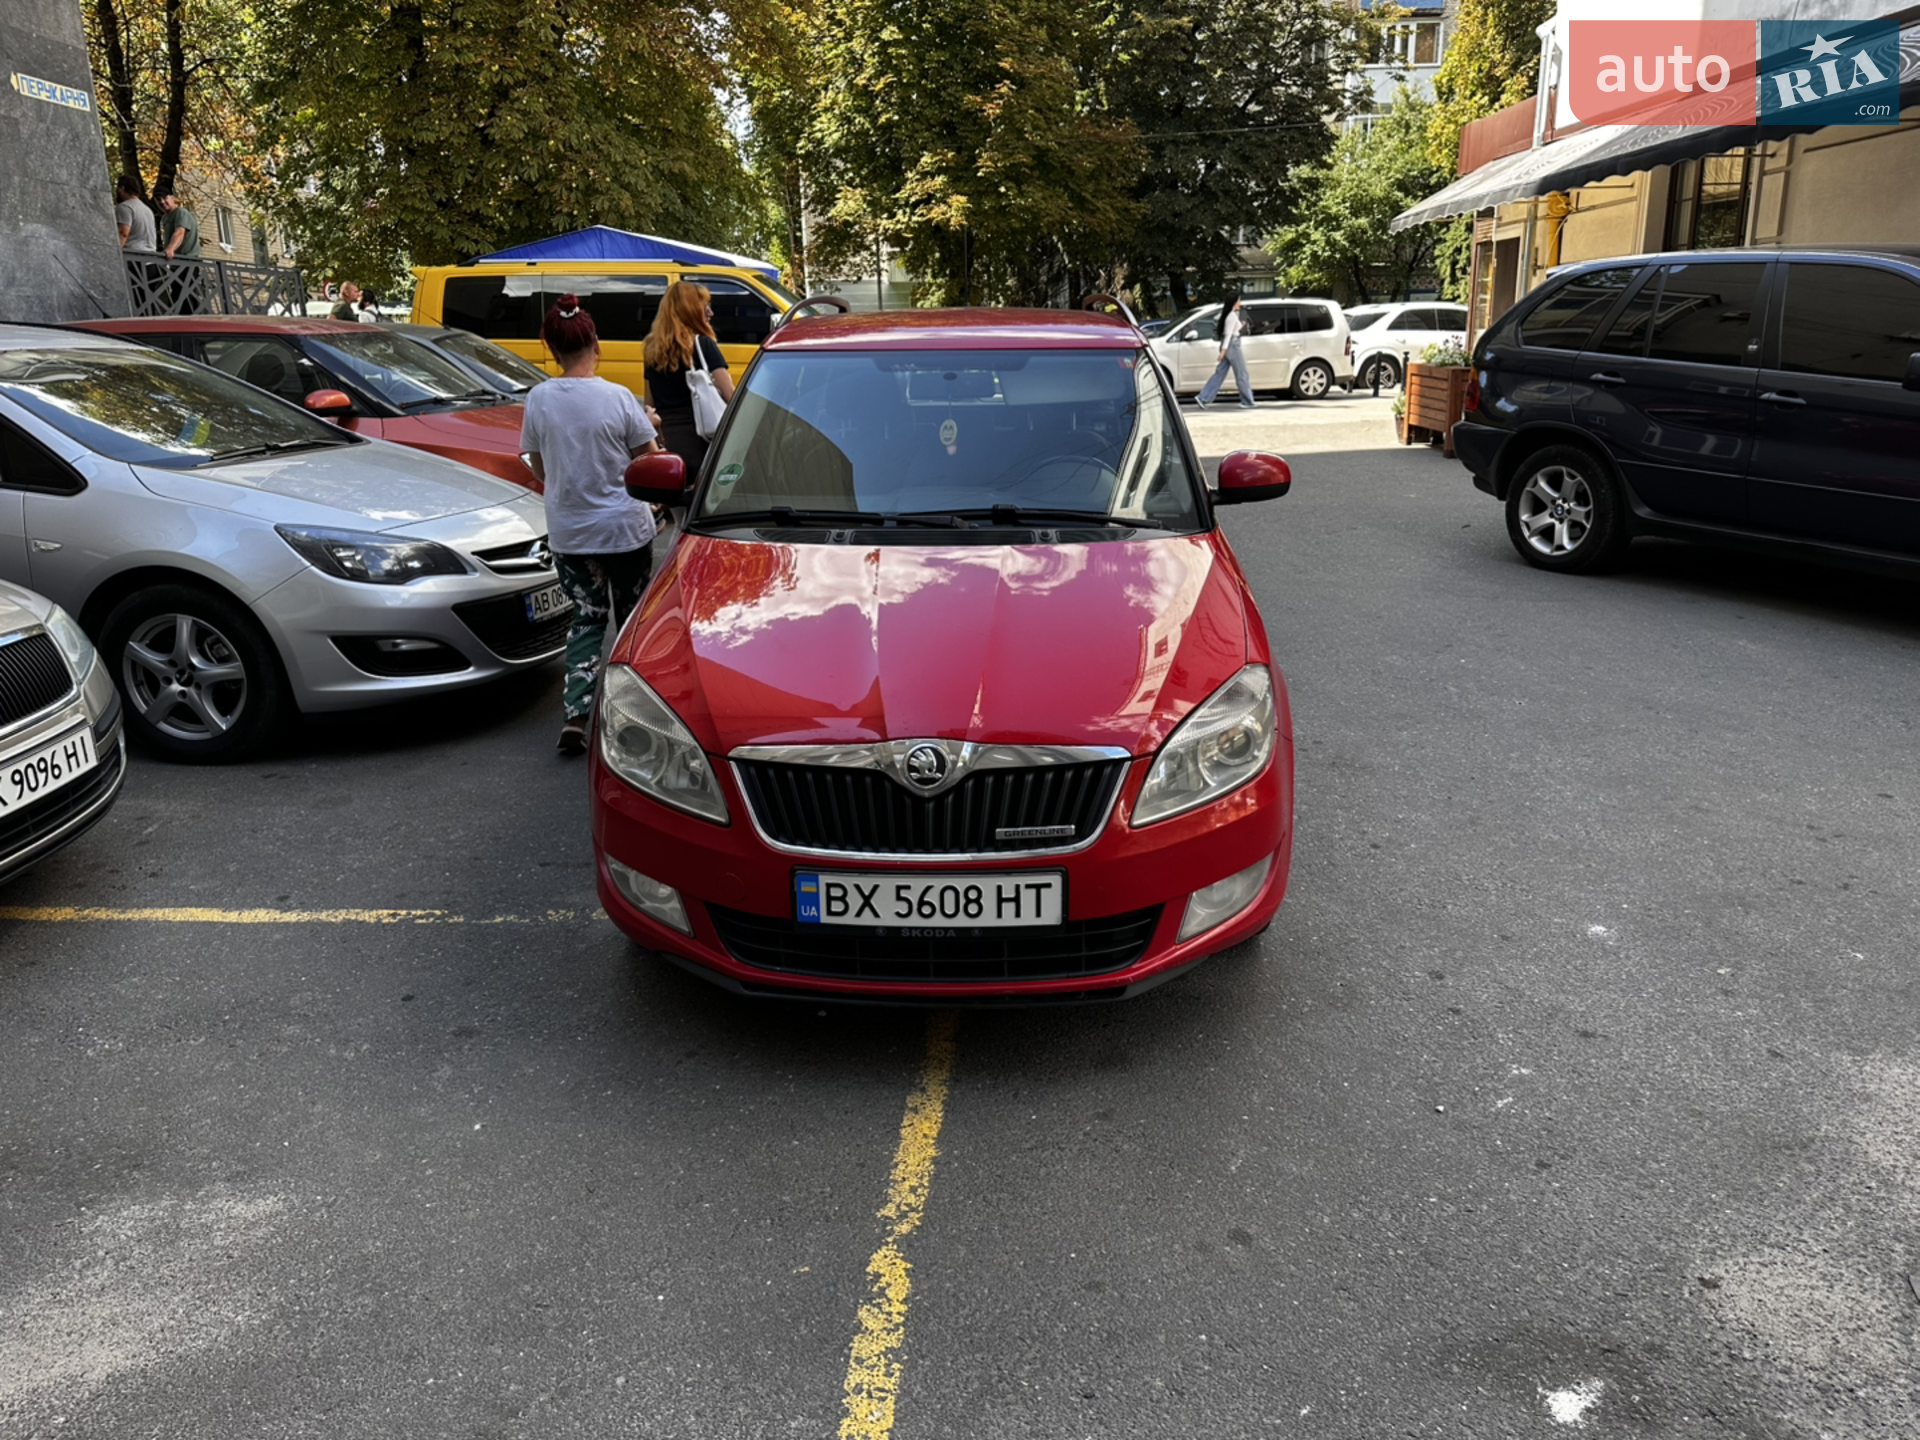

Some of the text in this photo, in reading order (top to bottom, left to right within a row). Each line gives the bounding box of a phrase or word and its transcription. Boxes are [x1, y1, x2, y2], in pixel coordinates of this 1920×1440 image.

[20, 76, 89, 109] ПЕРУКАРНЯ
[533, 591, 551, 615] AB
[10, 749, 62, 801] 9096
[63, 735, 90, 773] HI
[1004, 827, 1068, 838] GREENLINE
[801, 905, 818, 917] UA
[825, 881, 1053, 919] BX 5608 HT
